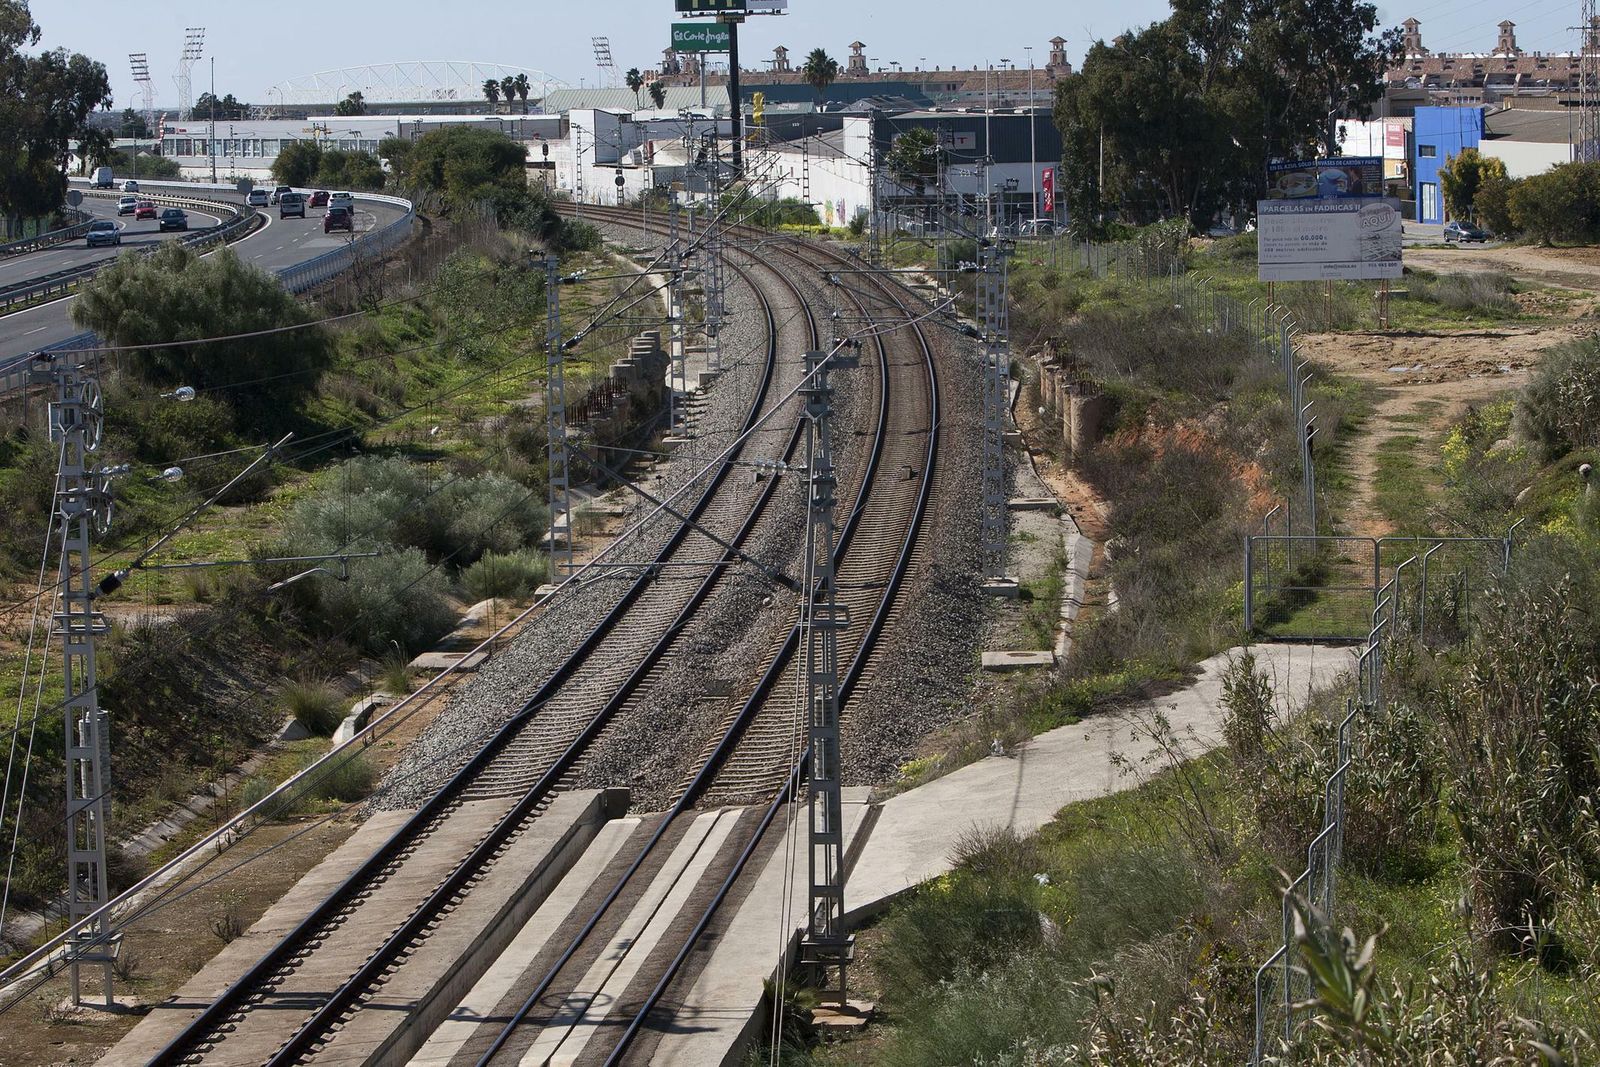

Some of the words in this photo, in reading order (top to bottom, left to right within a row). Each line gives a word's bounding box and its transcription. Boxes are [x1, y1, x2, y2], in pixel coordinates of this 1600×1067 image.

[673, 30, 683, 41] El
[683, 30, 705, 41] Corte
[1264, 205, 1304, 213] PARCELAS
[1314, 204, 1353, 212] FADRICAS
